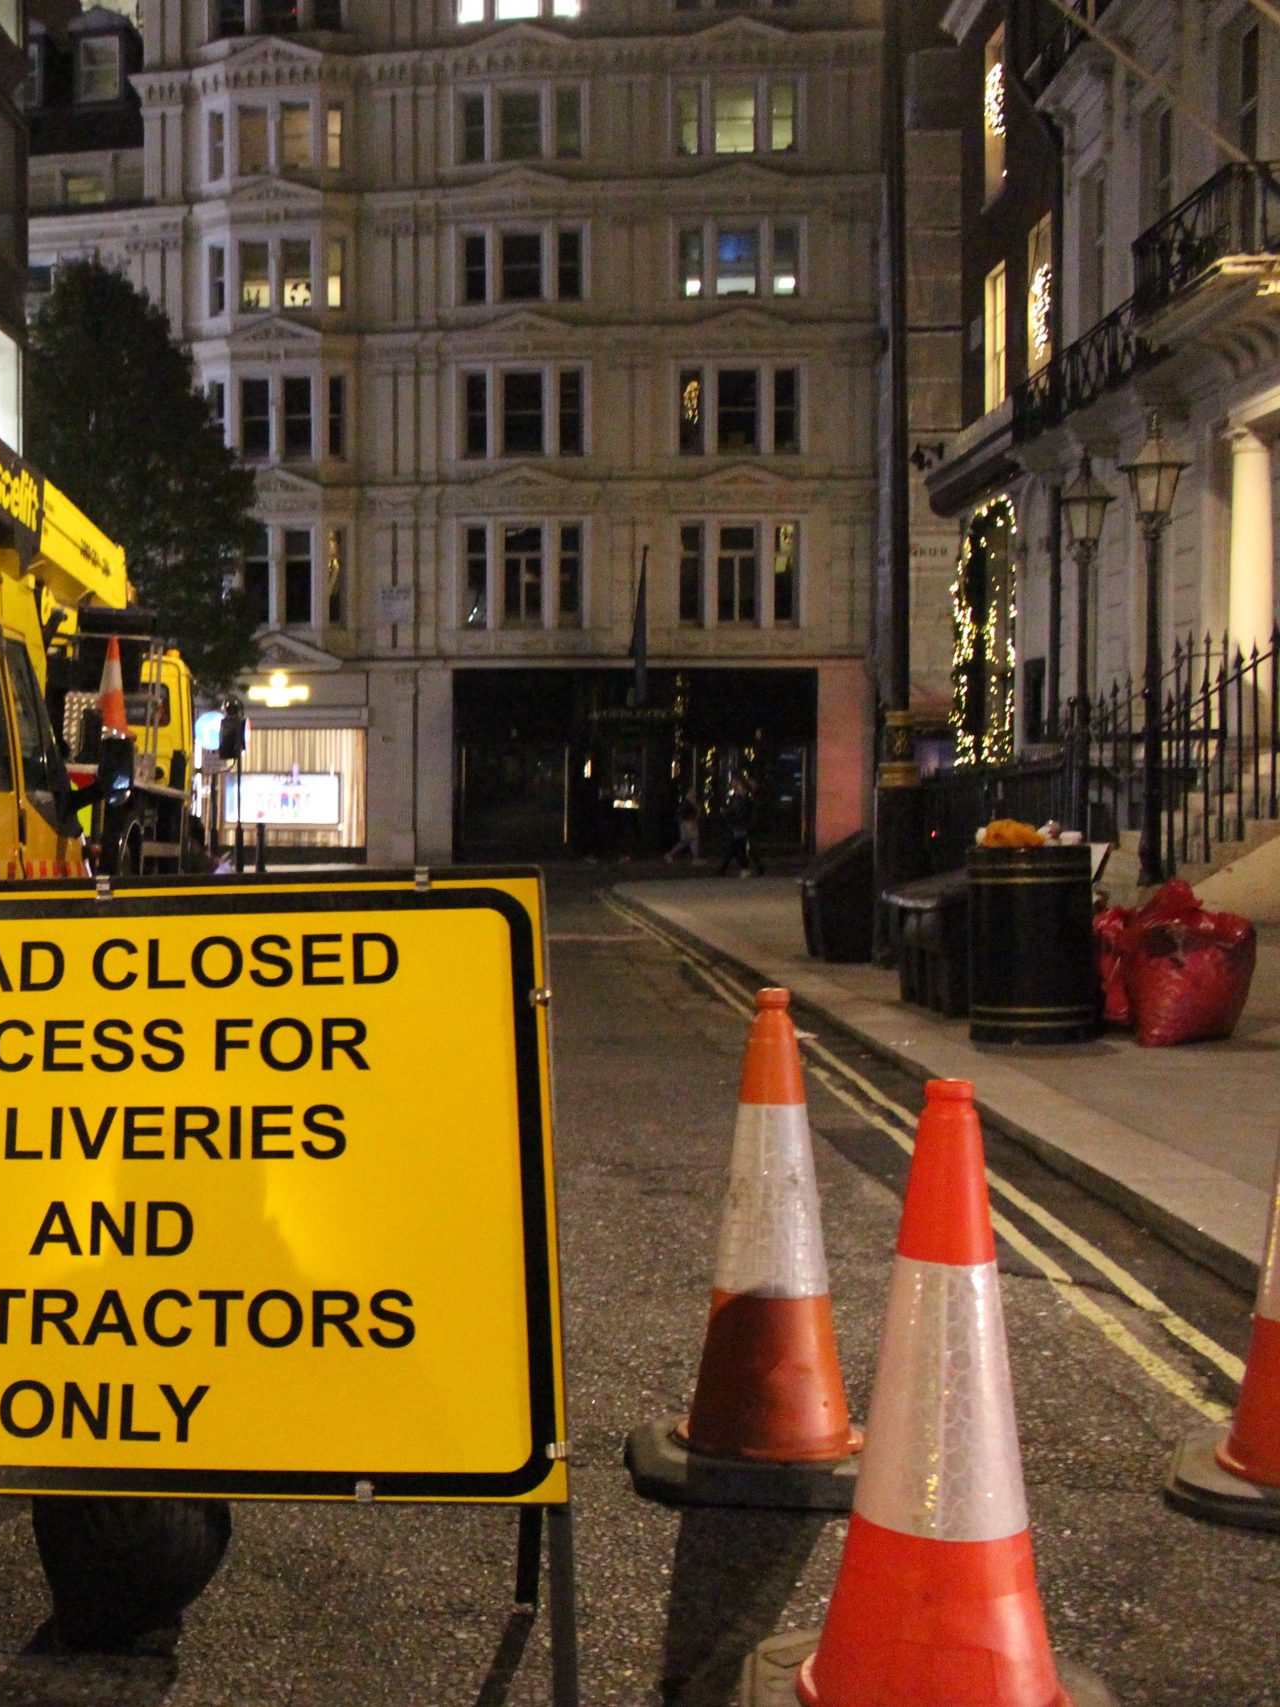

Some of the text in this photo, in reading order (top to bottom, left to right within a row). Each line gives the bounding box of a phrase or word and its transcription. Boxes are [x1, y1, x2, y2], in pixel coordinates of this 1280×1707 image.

[92, 932, 399, 990] CLOSED
[214, 1018, 370, 1071] FOR
[29, 1201, 194, 1257] AND
[0, 1380, 210, 1443] ONLY
